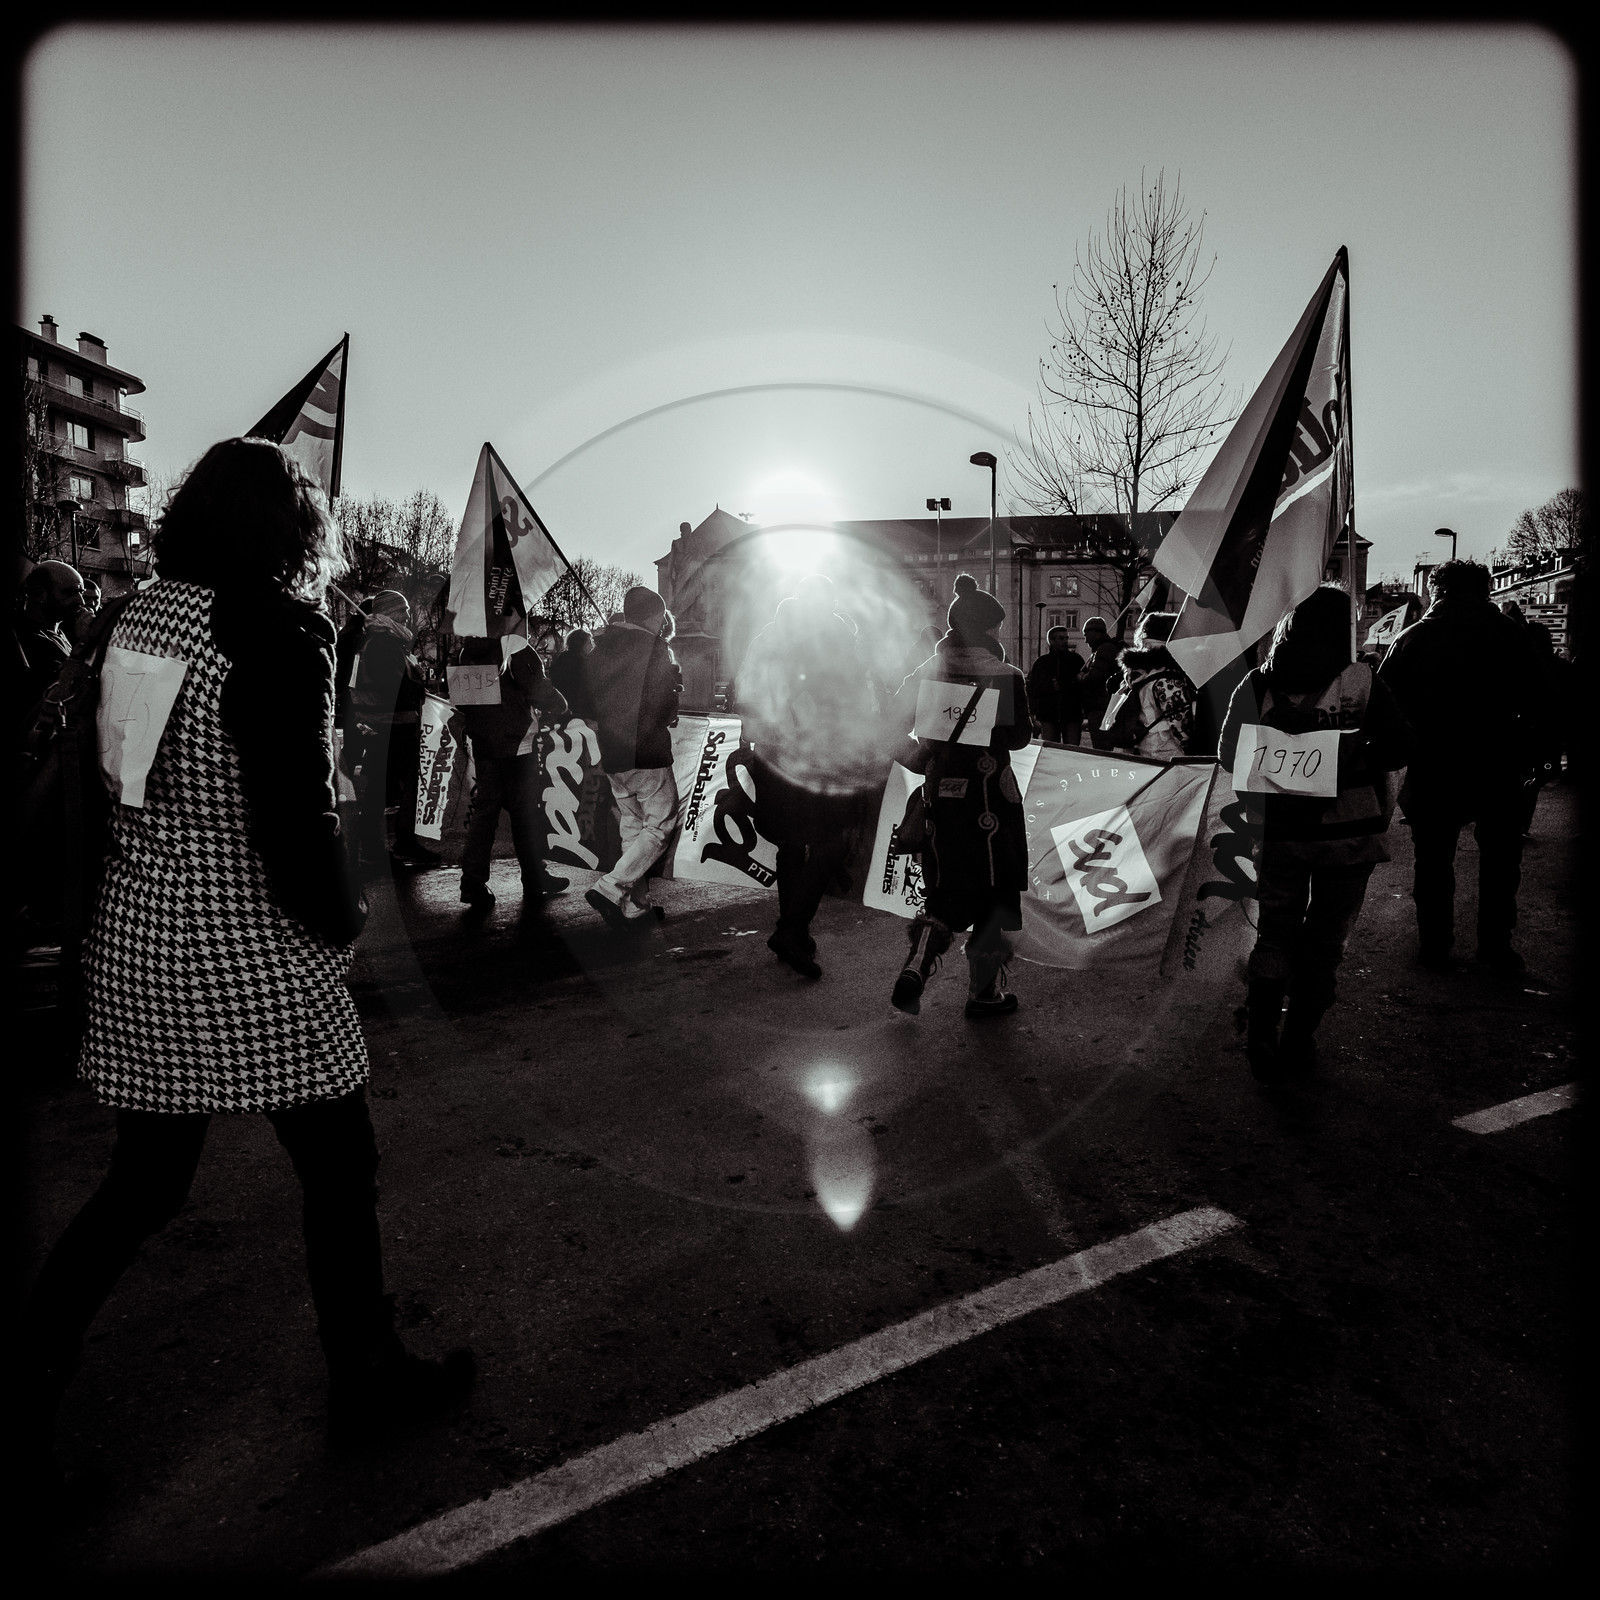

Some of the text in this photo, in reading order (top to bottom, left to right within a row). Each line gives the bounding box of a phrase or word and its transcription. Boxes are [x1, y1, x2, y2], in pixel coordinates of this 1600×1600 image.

[450, 673, 494, 691] 1995
[1253, 745, 1323, 778] 1970
[685, 731, 726, 831] Solidaires
[747, 861, 773, 883] PTT
